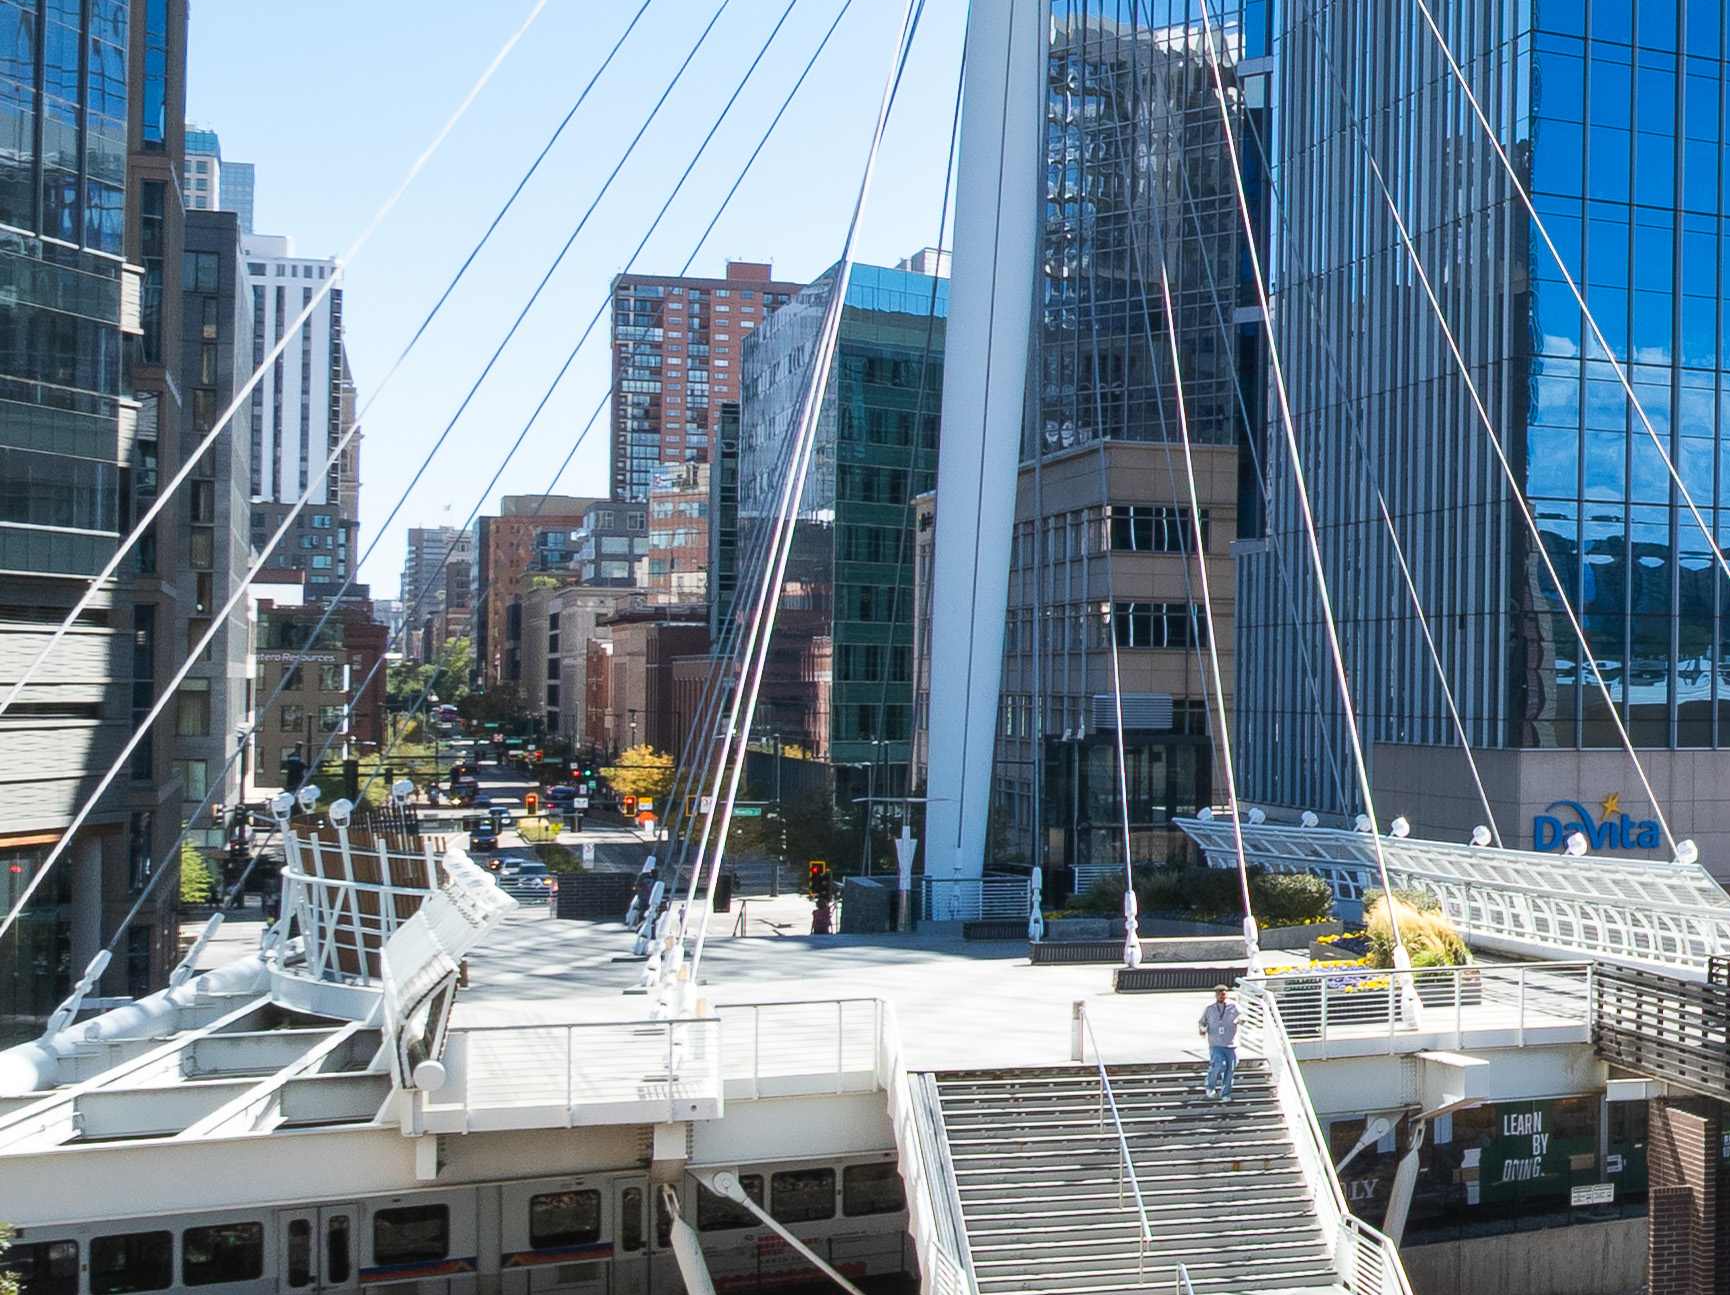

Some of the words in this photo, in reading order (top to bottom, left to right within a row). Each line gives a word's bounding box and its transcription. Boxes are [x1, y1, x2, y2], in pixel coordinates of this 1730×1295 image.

[256, 653, 280, 661] tero
[1503, 1111, 1542, 1136] LEARN
[1532, 1133, 1549, 1155] BY
